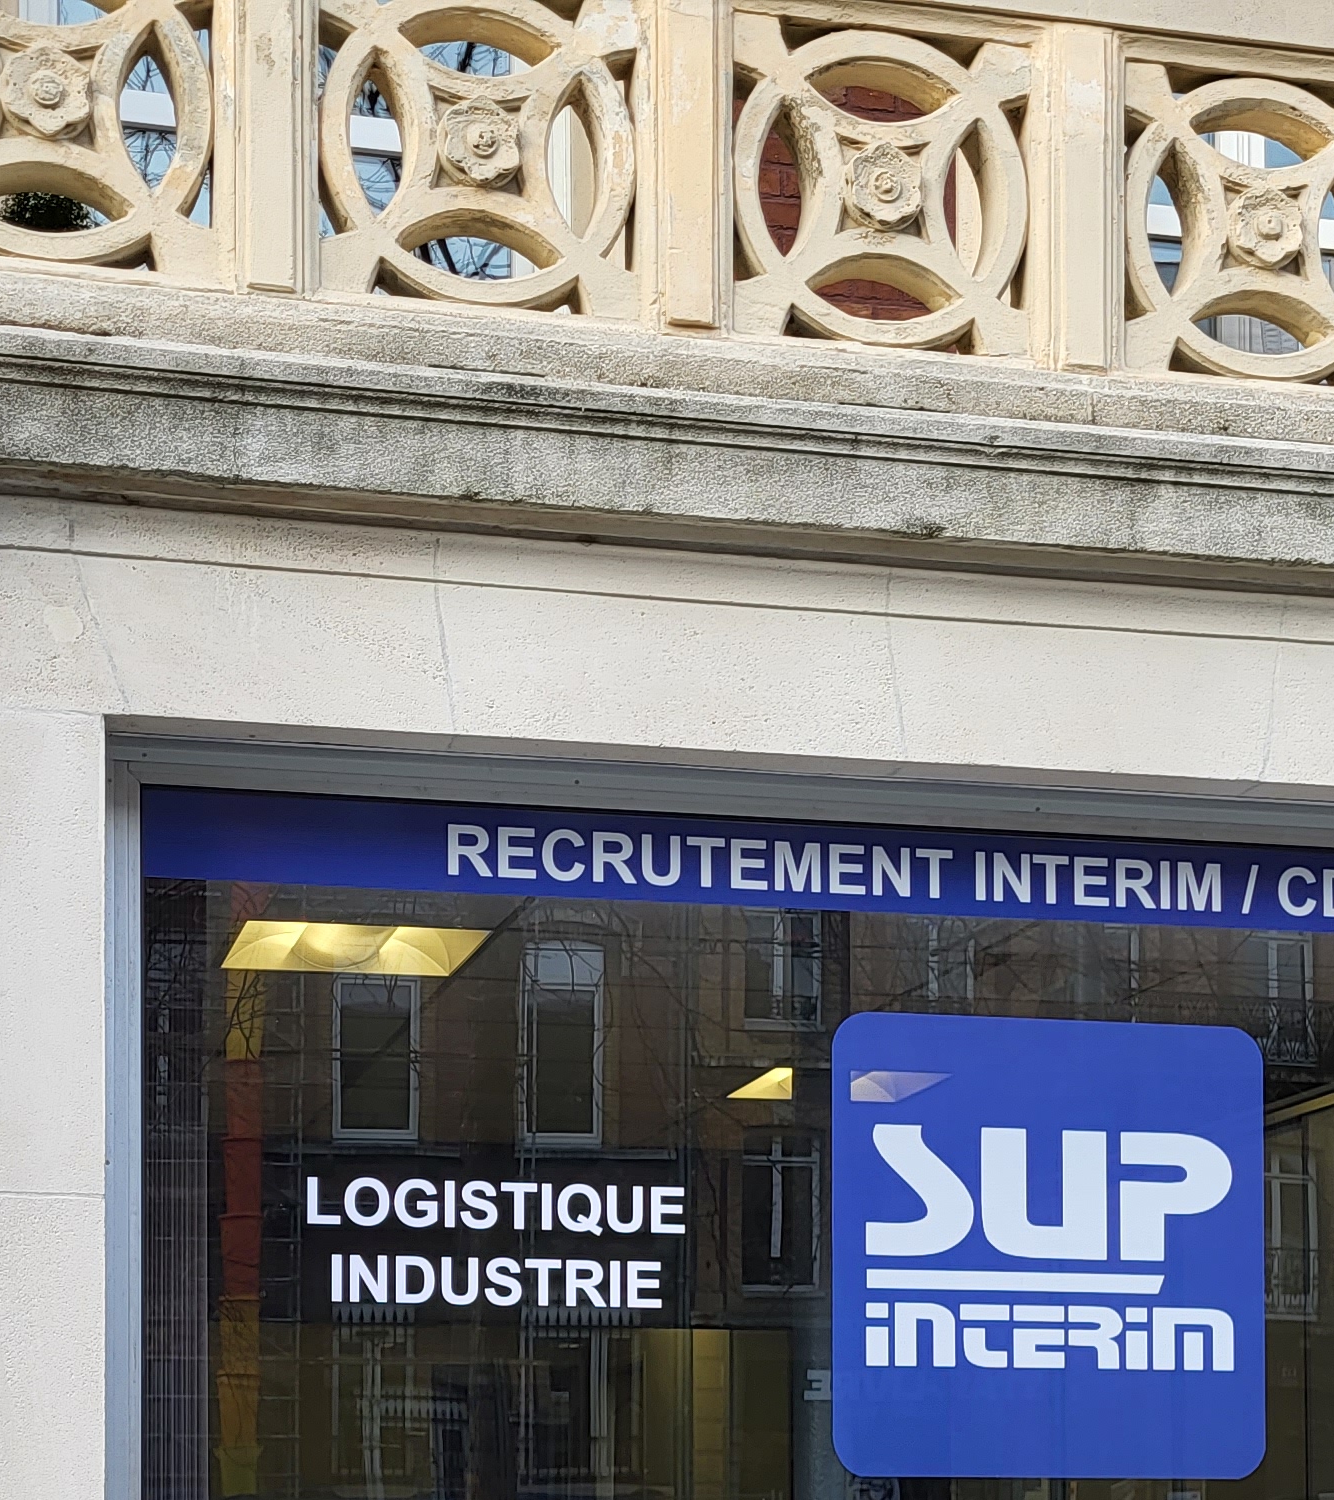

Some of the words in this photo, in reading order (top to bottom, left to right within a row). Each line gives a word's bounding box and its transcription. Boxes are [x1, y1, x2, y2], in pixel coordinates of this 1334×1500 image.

[448, 825, 952, 898] RECRUTEMENT
[976, 851, 1221, 911] INTERIM
[1242, 866, 1258, 914] /
[307, 1177, 685, 1236] LOGISTIQUE
[866, 1124, 1232, 1261] SUP
[332, 1254, 662, 1308] INDUSTRIE
